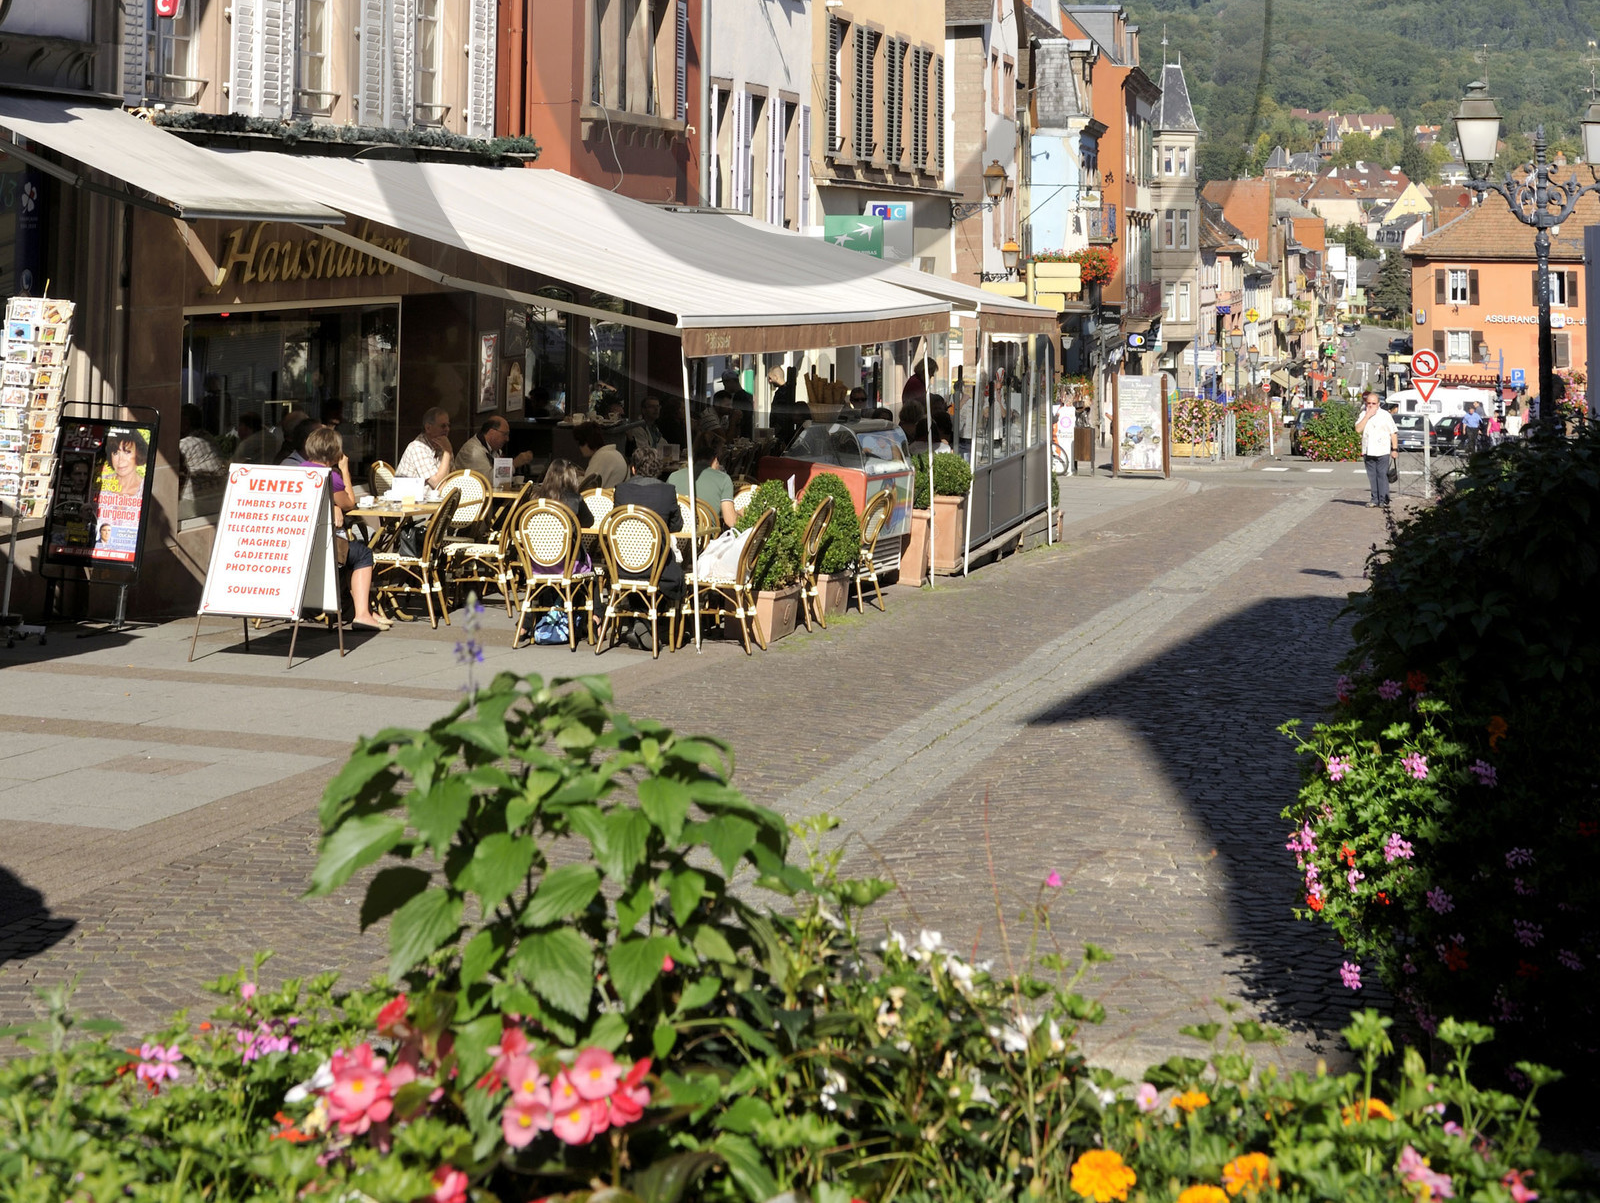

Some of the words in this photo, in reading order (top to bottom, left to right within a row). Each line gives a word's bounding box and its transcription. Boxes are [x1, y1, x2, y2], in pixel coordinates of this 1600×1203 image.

[874, 206, 903, 218] CIC
[1515, 371, 1521, 380] P
[249, 479, 304, 493] VENTES
[237, 499, 276, 508] TIMBRES
[279, 501, 307, 510] POSTE
[230, 511, 268, 521] TIMBRES
[271, 513, 309, 523] FISCAUX
[228, 524, 274, 534] TELECARTES
[276, 527, 306, 536] MONDE
[237, 538, 291, 549] (MAGHREB)
[234, 551, 289, 561] GADJETERIE
[226, 563, 292, 574] PHOTOCOPIES
[227, 585, 280, 596] SOUVENIRS
